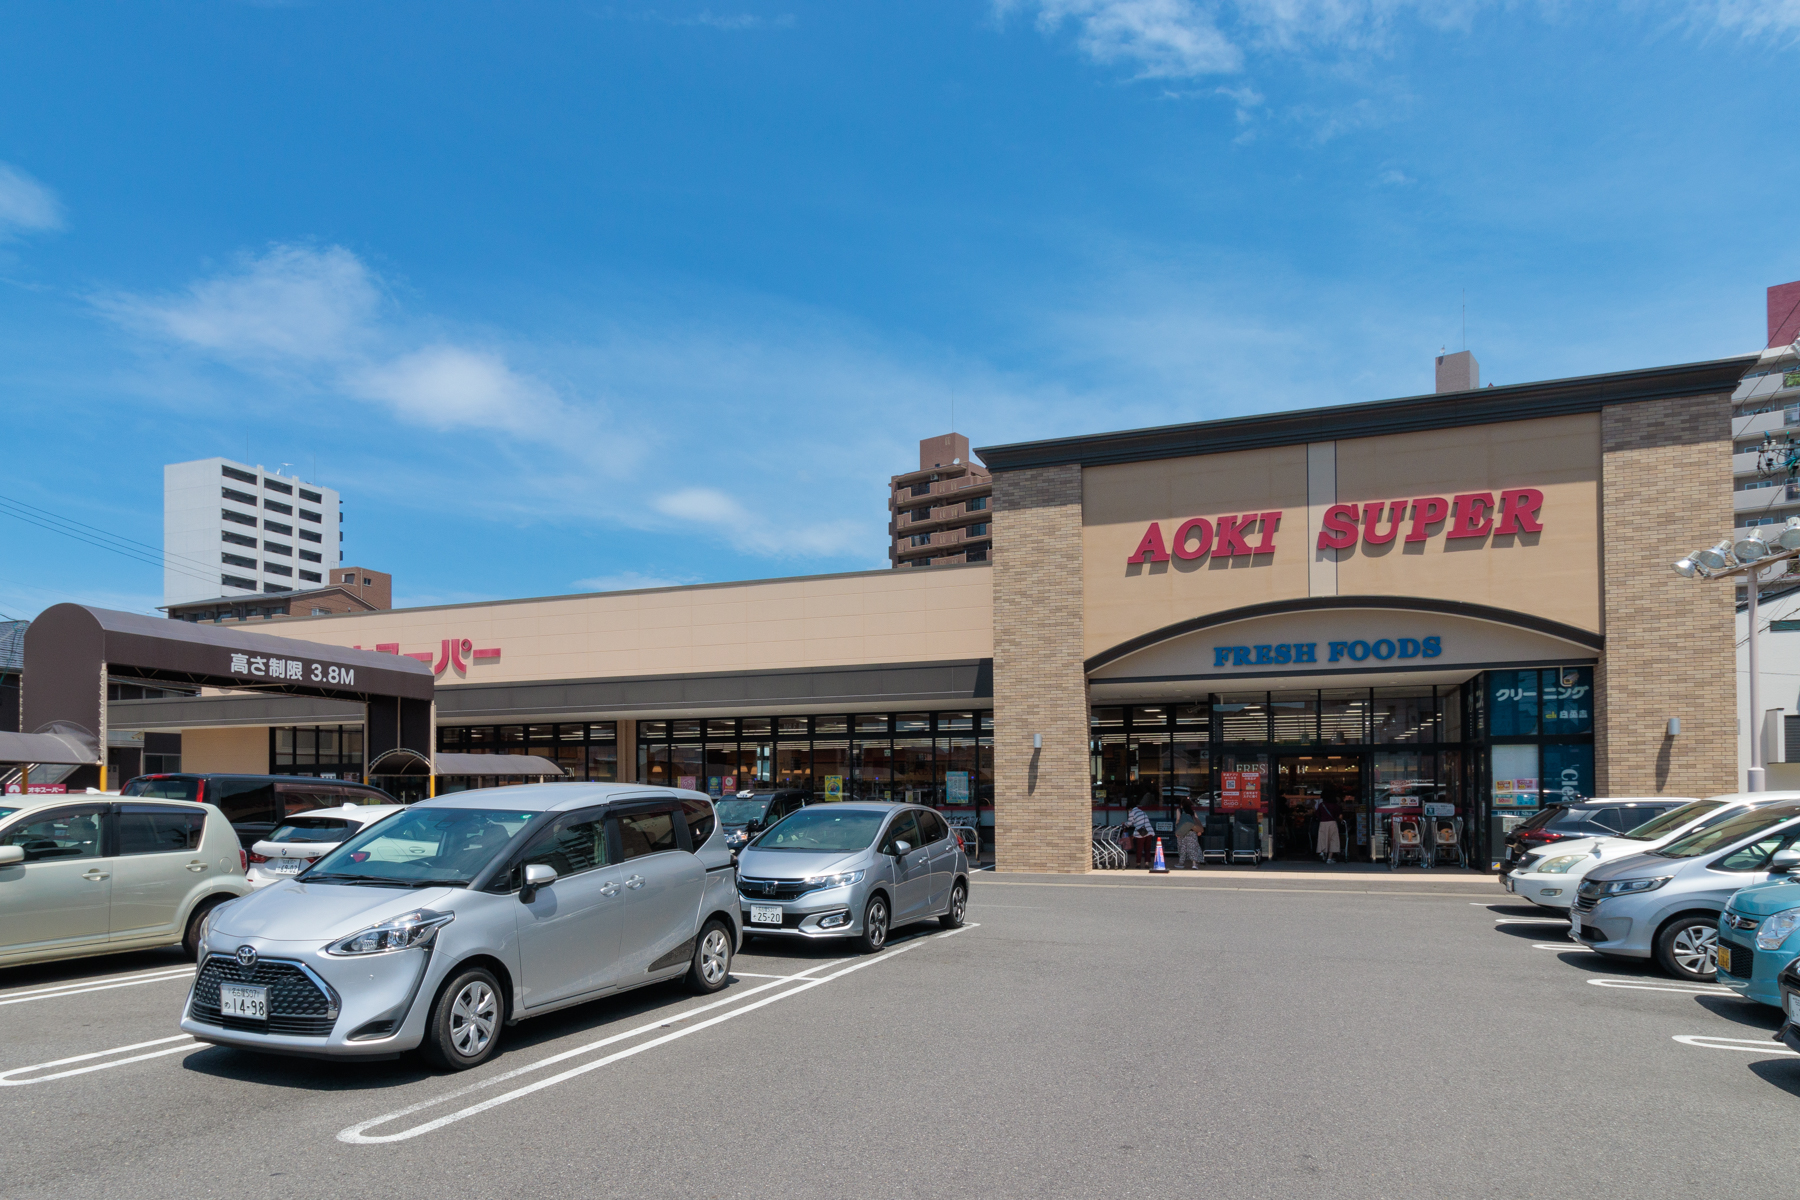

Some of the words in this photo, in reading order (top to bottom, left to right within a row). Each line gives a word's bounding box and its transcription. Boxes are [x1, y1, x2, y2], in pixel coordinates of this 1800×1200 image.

[1127, 510, 1282, 565] AOKI
[1317, 488, 1544, 551] SUPER
[1213, 642, 1317, 667] FRESH
[1328, 636, 1442, 662] FOODS
[230, 653, 303, 681] 高さ制限
[311, 663, 355, 686] 3.8M
[1496, 685, 1590, 702] クリーニング
[757, 912, 781, 923] 25-20
[233, 997, 265, 1016] 14-98
